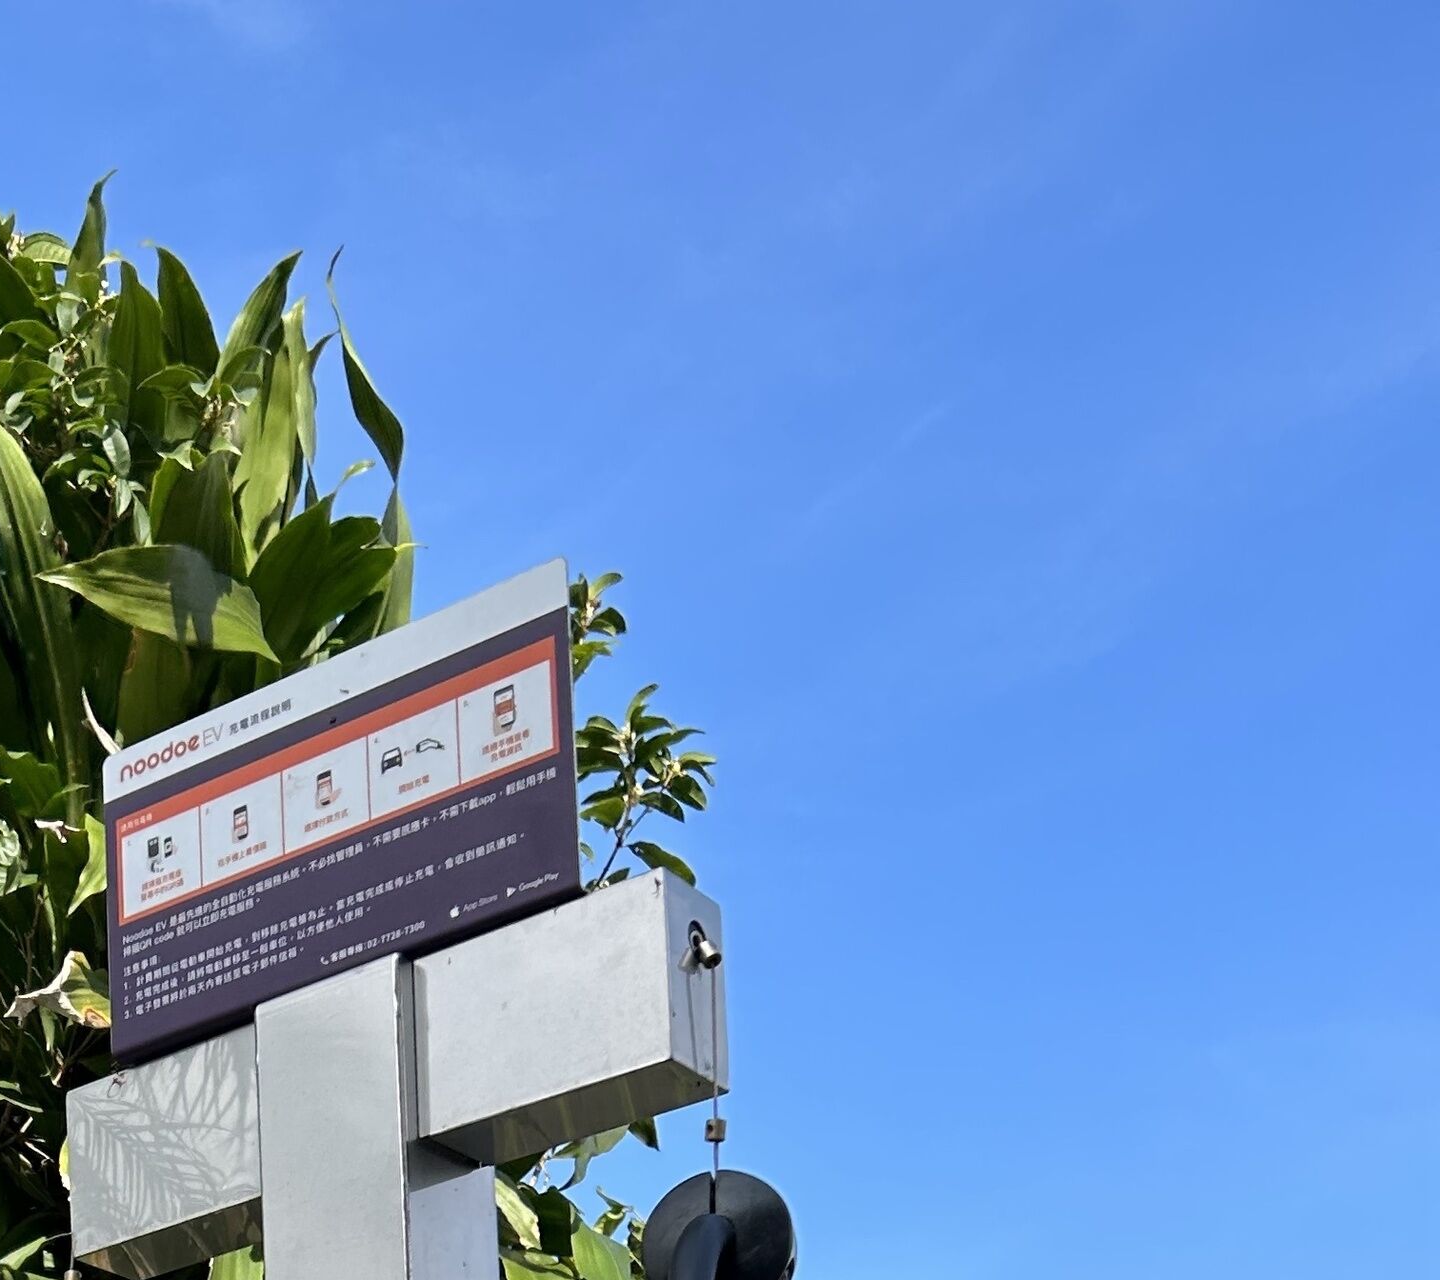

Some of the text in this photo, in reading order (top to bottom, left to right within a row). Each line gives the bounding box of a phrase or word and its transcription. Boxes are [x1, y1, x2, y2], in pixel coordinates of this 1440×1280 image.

[120, 733, 199, 782] noodoe
[202, 723, 223, 746] EV
[518, 869, 559, 893] Google Play
[462, 900, 477, 914] App
[122, 925, 153, 946] Noodoe
[155, 919, 167, 933] EV
[153, 928, 174, 945] code
